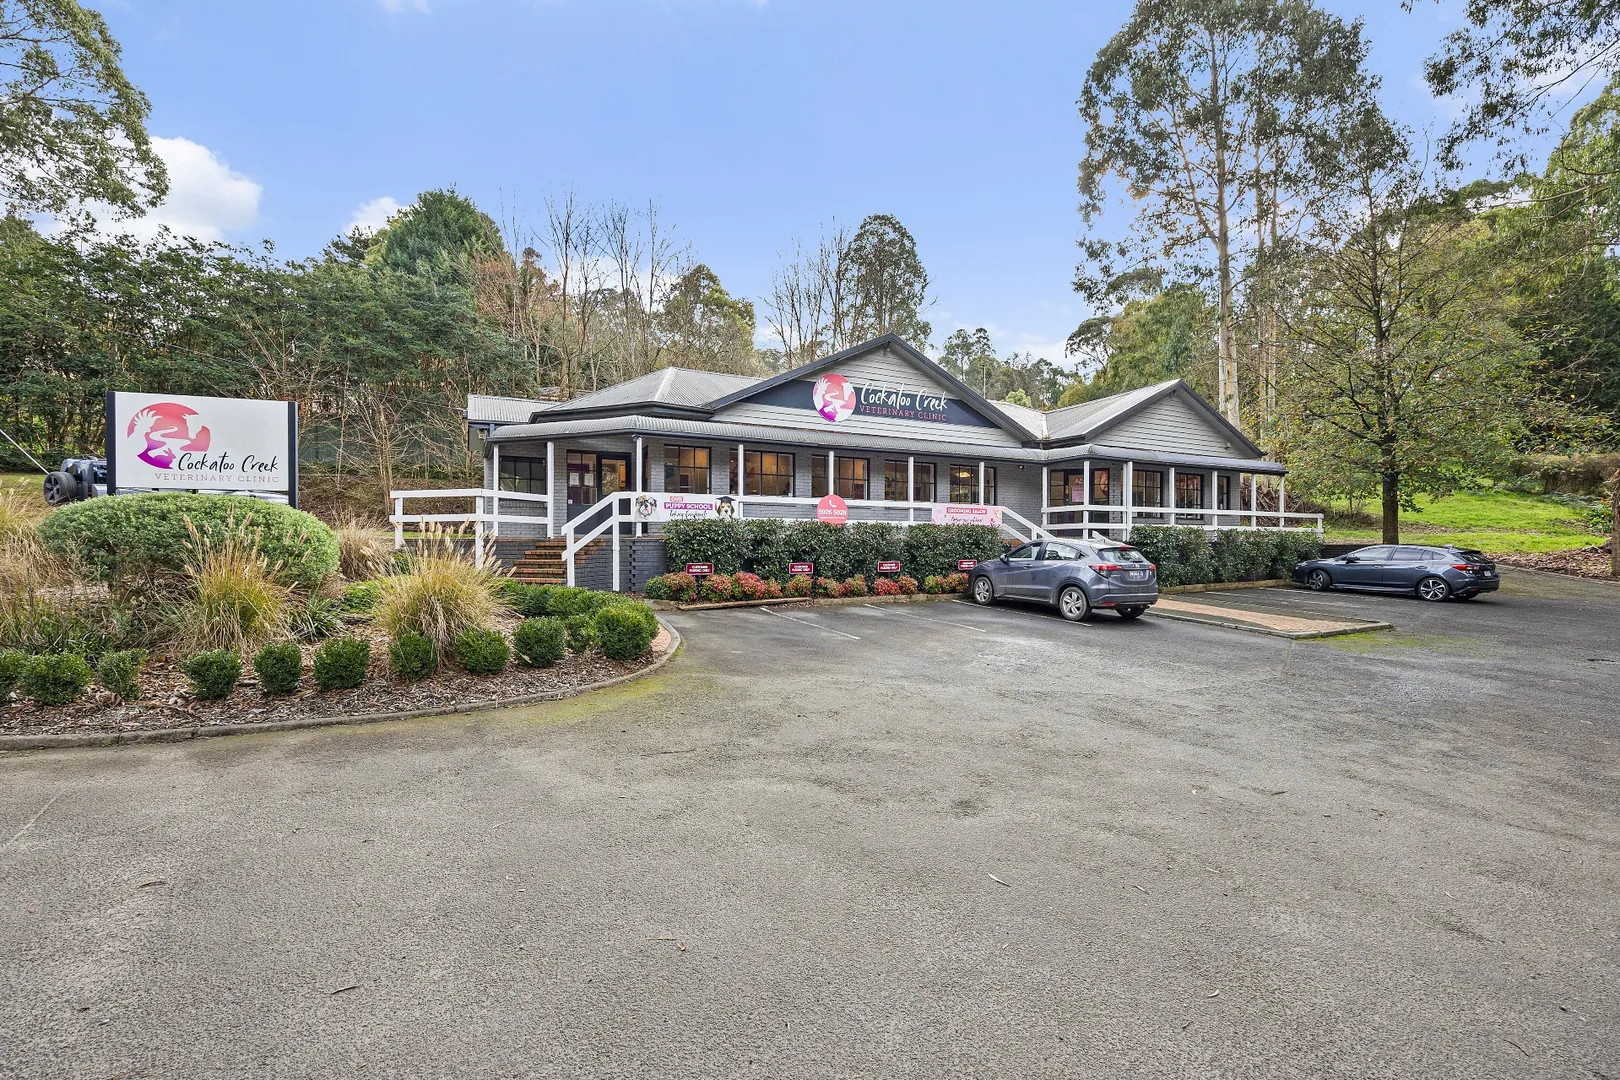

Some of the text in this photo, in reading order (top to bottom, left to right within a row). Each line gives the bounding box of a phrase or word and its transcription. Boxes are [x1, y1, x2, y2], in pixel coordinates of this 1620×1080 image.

[860, 381, 948, 411] Cockatoo Creek
[859, 405, 947, 421] VETERINARY CLINIC
[178, 452, 279, 473] Cockatoo Creek
[155, 473, 279, 483] VETERINARY CLINIC
